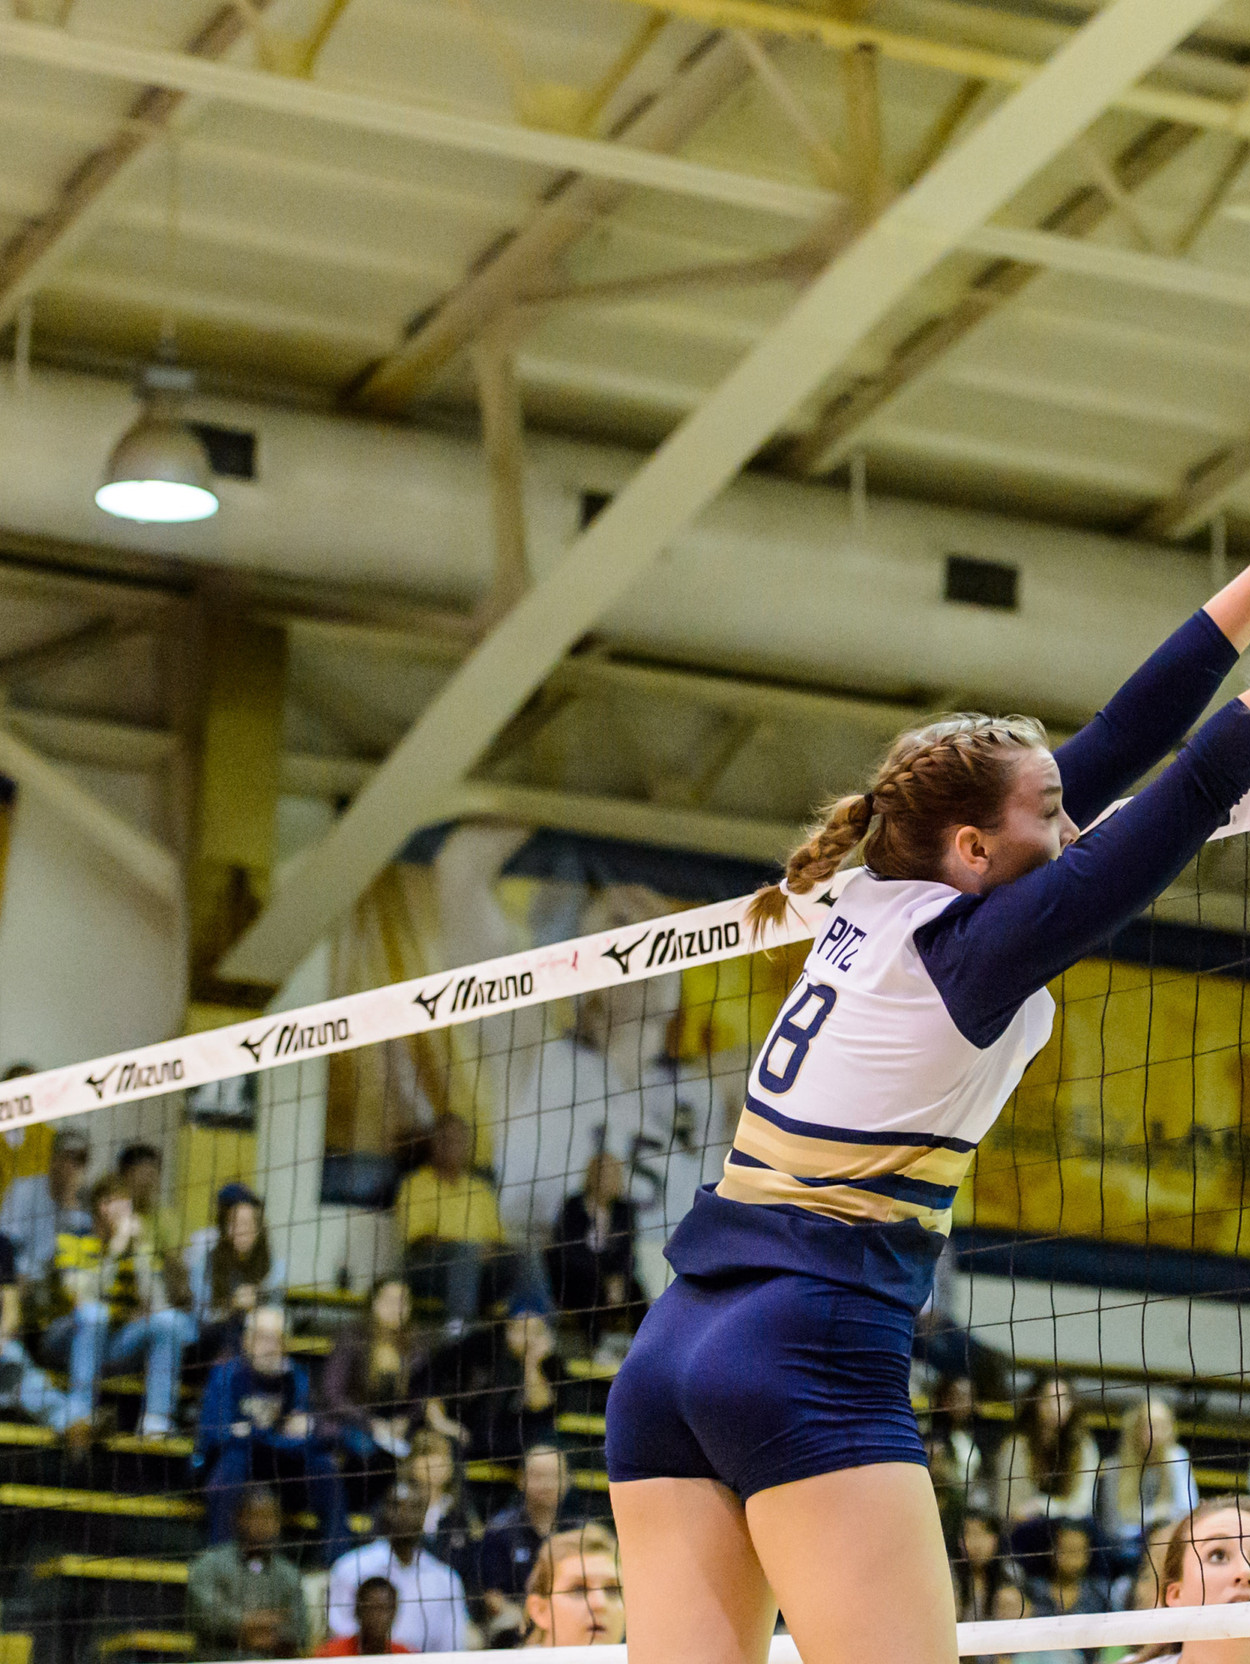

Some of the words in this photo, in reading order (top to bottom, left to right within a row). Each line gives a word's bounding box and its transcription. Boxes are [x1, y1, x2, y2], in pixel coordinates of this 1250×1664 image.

[645, 921, 740, 969] MIZUNO
[450, 972, 533, 1014] MIZUNO
[275, 1018, 349, 1057] MIZUNO
[758, 982, 838, 1097] 8
[116, 1058, 185, 1094] MIZUNO
